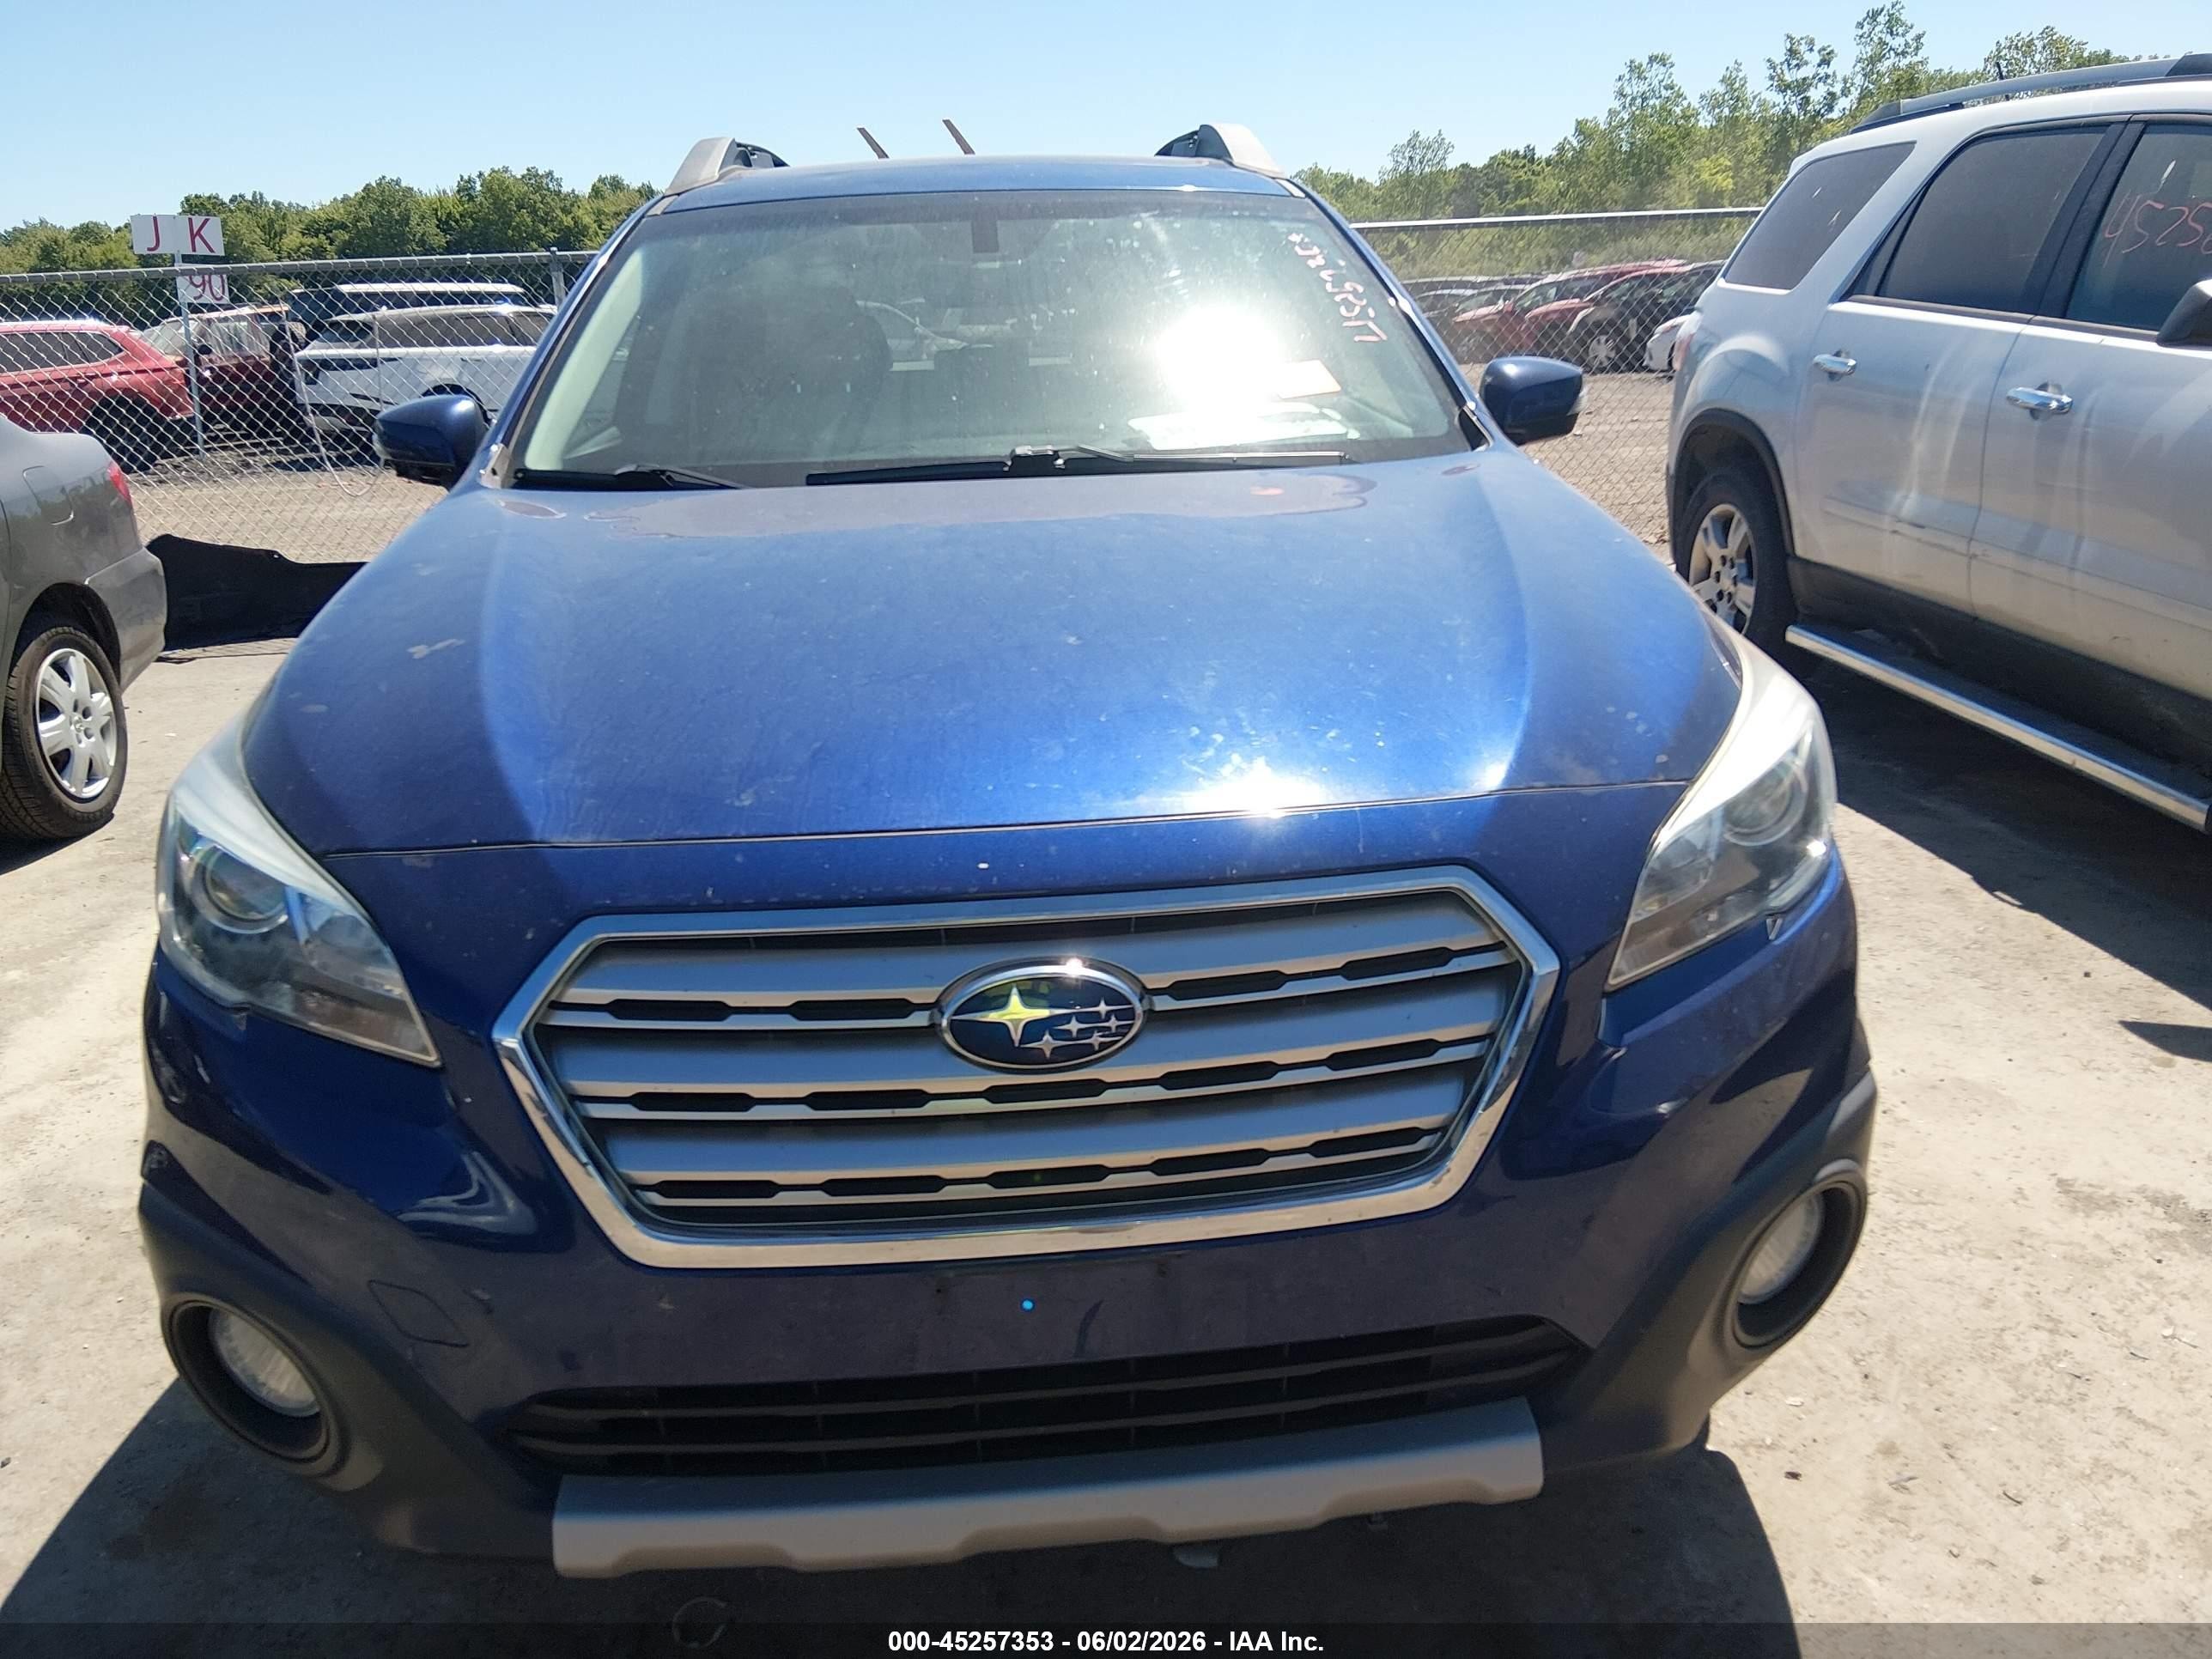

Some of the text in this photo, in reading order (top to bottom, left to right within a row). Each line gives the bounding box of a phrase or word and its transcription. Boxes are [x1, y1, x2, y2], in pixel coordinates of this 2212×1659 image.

[147, 216, 216, 253] J K
[189, 274, 226, 301] 90
